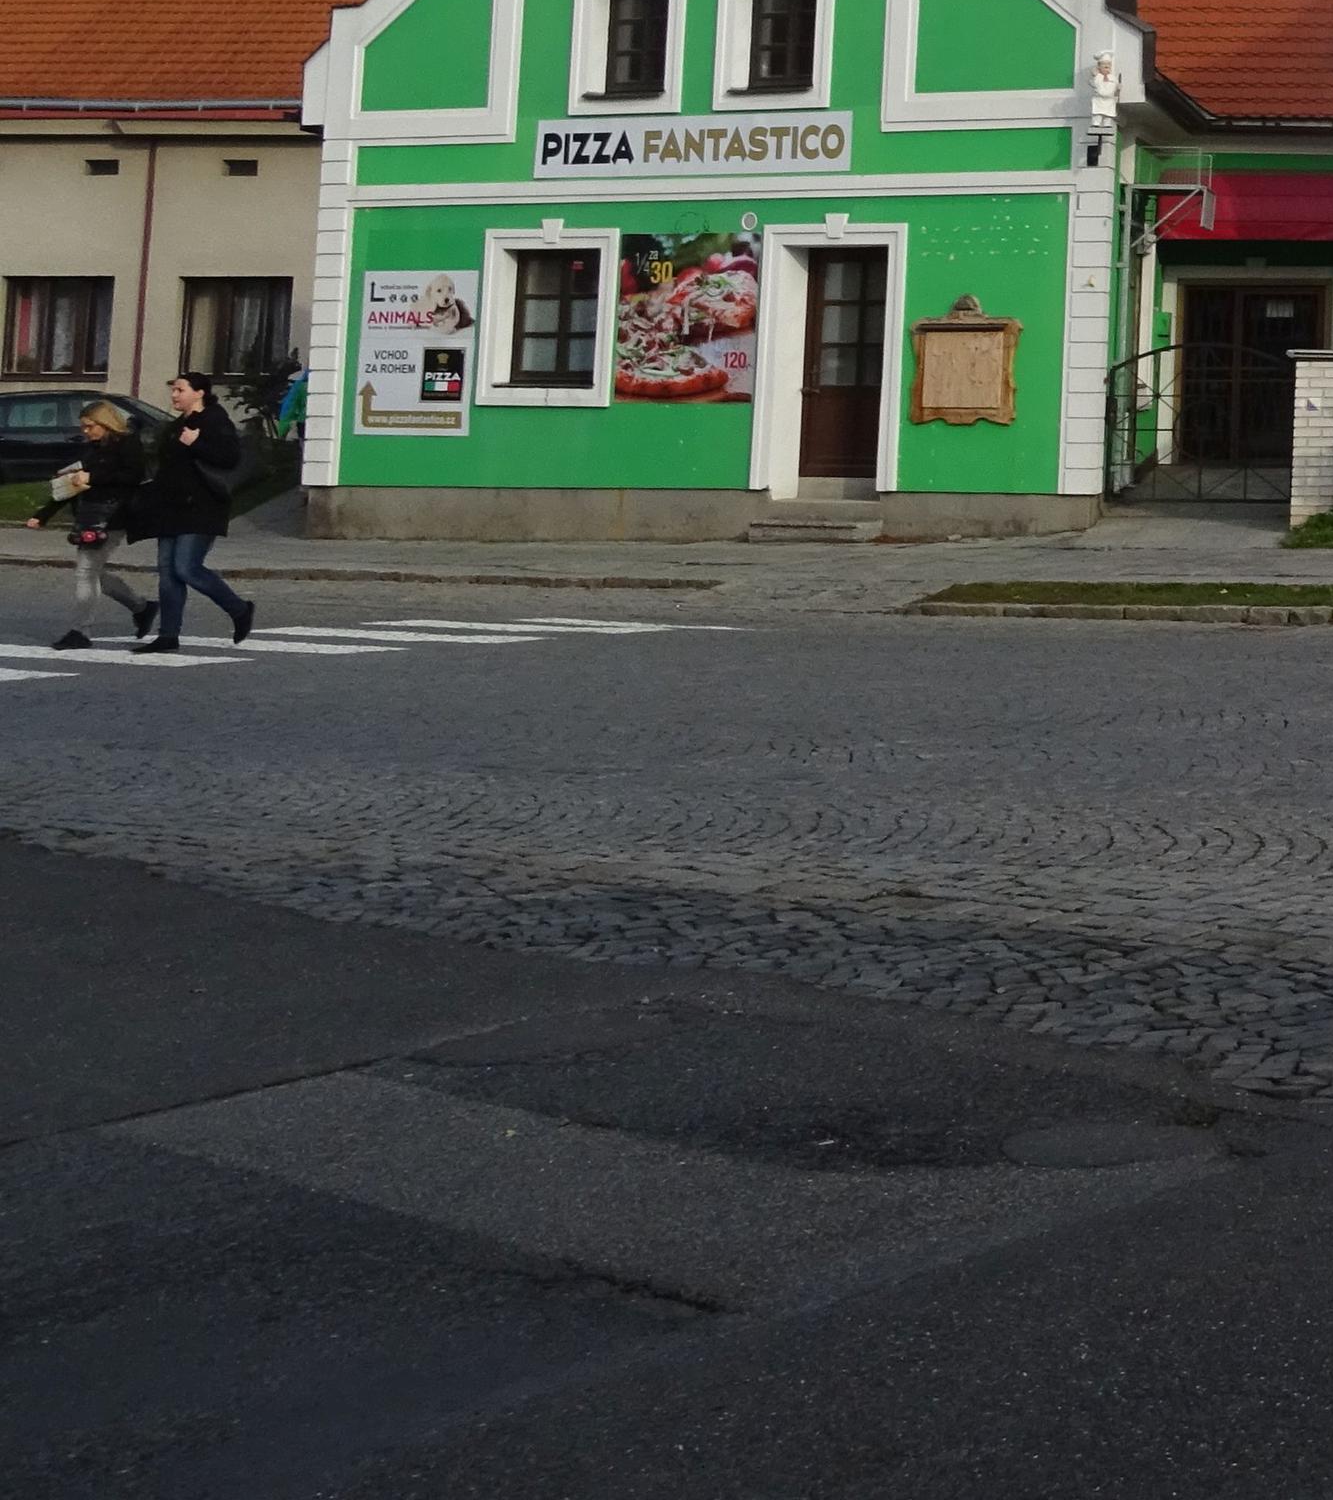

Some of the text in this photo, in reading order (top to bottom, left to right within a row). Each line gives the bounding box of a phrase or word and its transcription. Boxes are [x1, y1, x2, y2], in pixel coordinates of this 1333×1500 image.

[540, 123, 846, 166] PIZZA FANTASTICO
[367, 310, 434, 325] ANIMALS
[374, 350, 409, 361] VCHOD
[364, 363, 416, 374] ZA ROHEM
[424, 371, 462, 381] PIZZA
